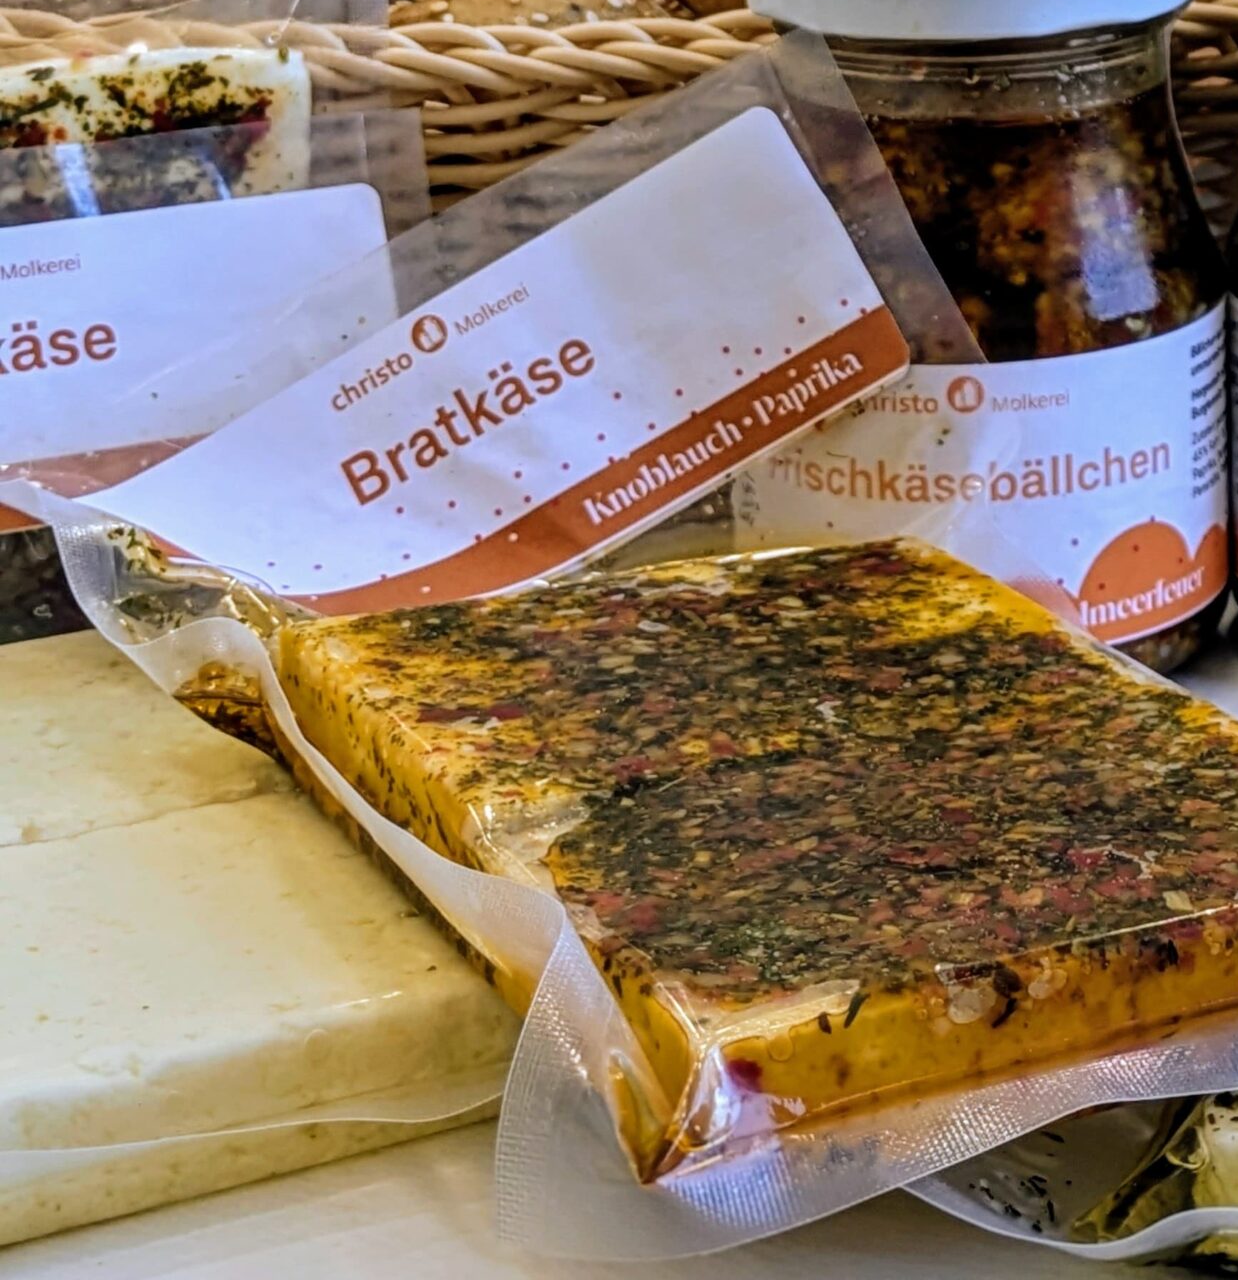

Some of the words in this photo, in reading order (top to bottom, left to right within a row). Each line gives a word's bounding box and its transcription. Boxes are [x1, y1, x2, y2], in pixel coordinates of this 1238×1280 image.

[1, 252, 82, 281] Molkerei
[0, 320, 118, 375] äse
[330, 352, 413, 412] christo
[453, 282, 531, 336] Molkerei
[340, 338, 596, 507] Bratkäse
[990, 388, 1071, 413] Molkerei
[582, 420, 744, 526] Knoblauch
[751, 352, 864, 426] Paprika
[1078, 566, 1206, 627] lmeerfeuer
